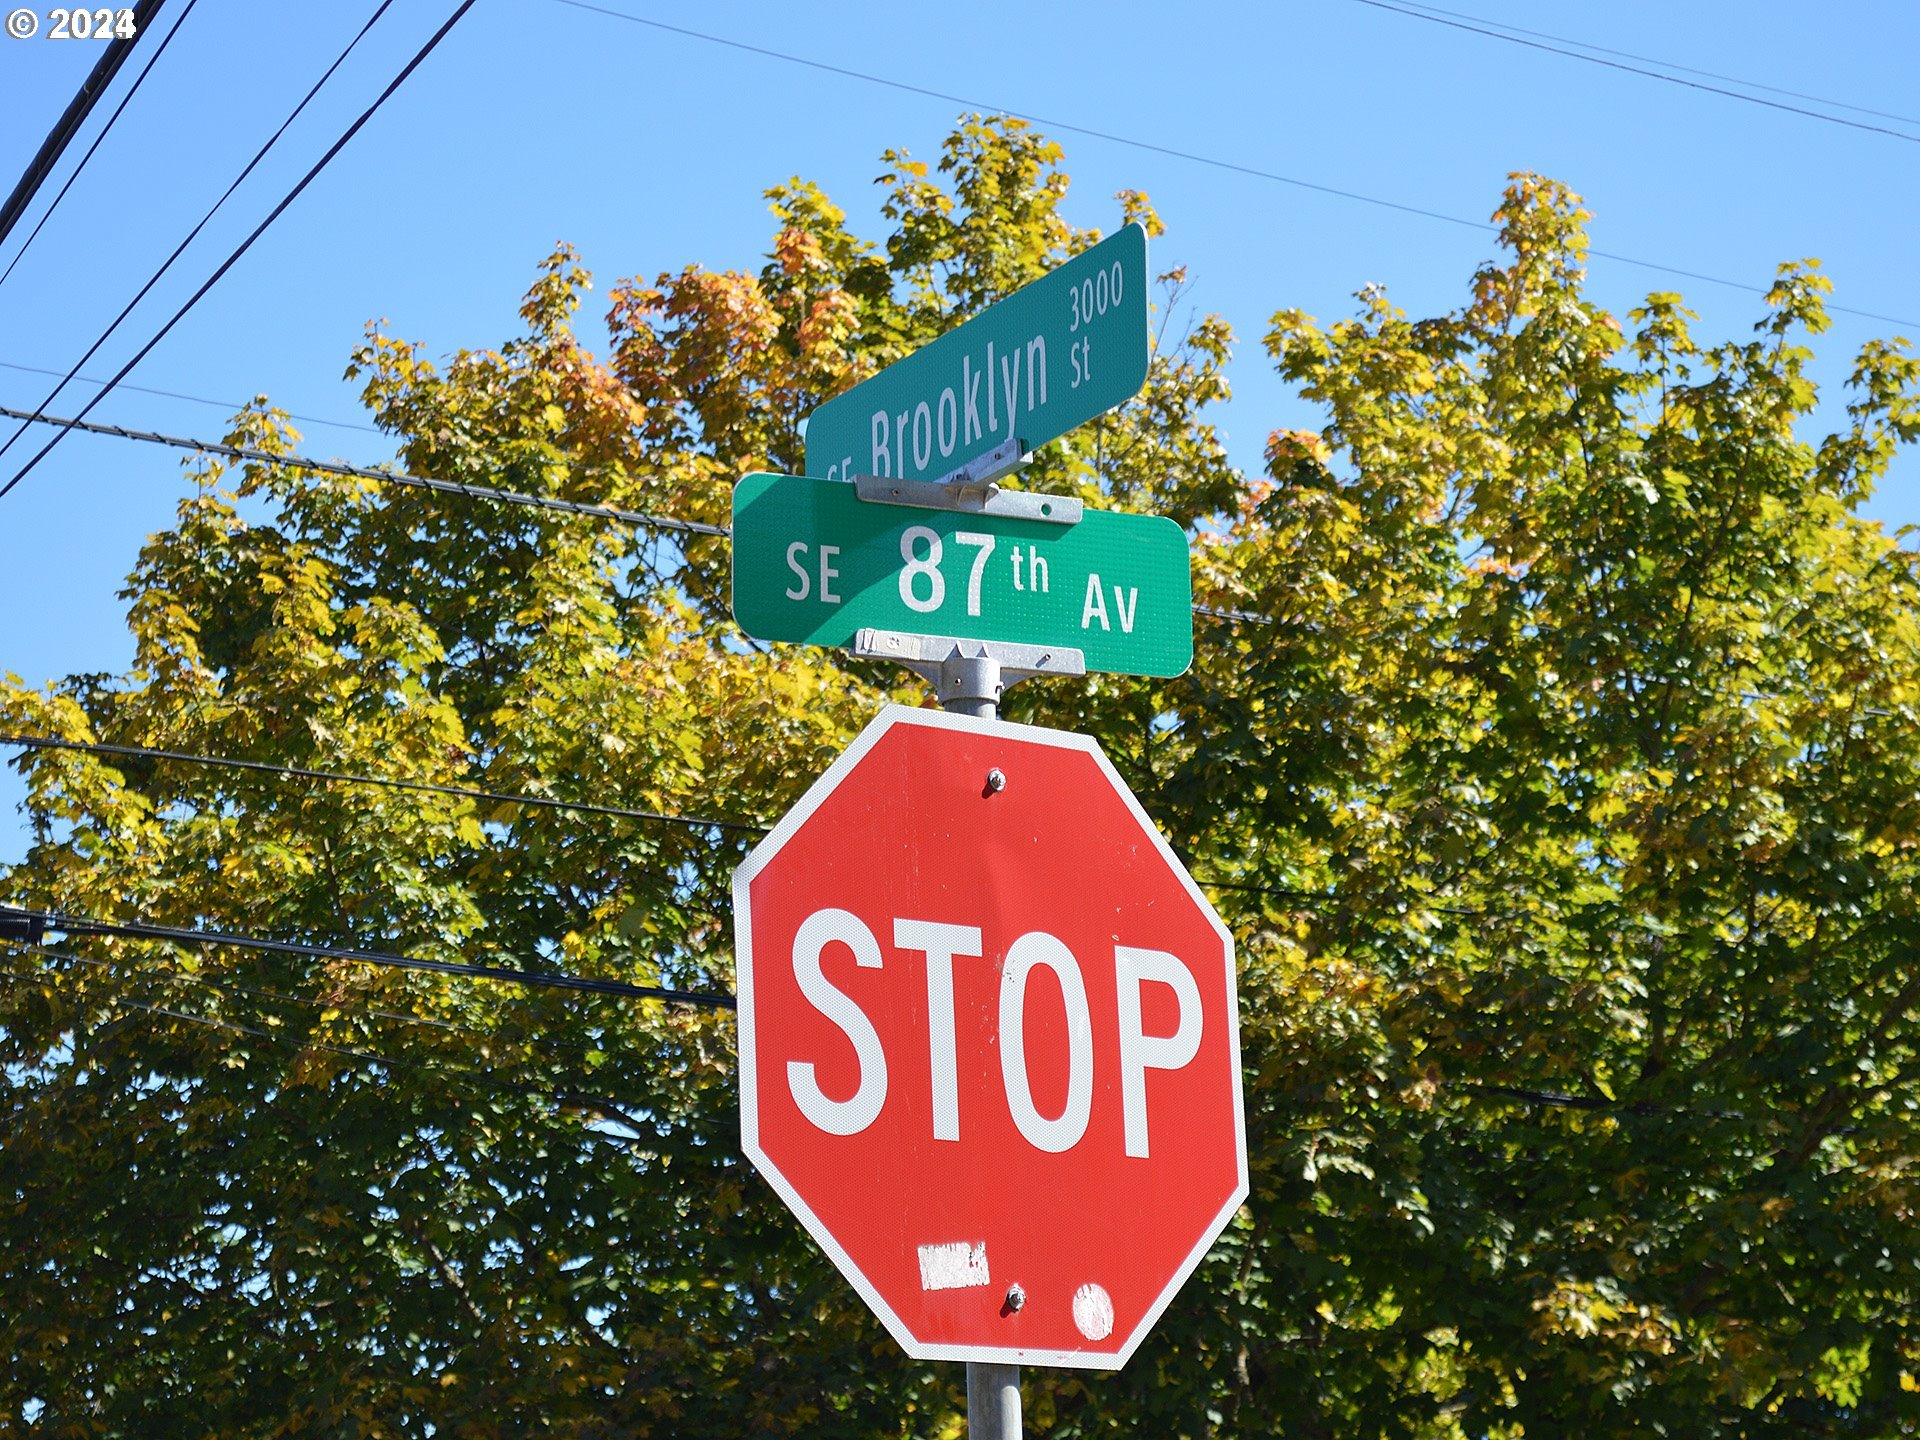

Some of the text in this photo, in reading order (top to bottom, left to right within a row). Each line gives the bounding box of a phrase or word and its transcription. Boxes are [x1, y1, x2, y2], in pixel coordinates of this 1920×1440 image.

[1069, 261, 1123, 332] 3000
[871, 334, 1047, 480] Brooklyn
[1070, 336, 1091, 388] St
[785, 526, 1138, 634] SE 87th Av
[787, 908, 1204, 1159] STOP
